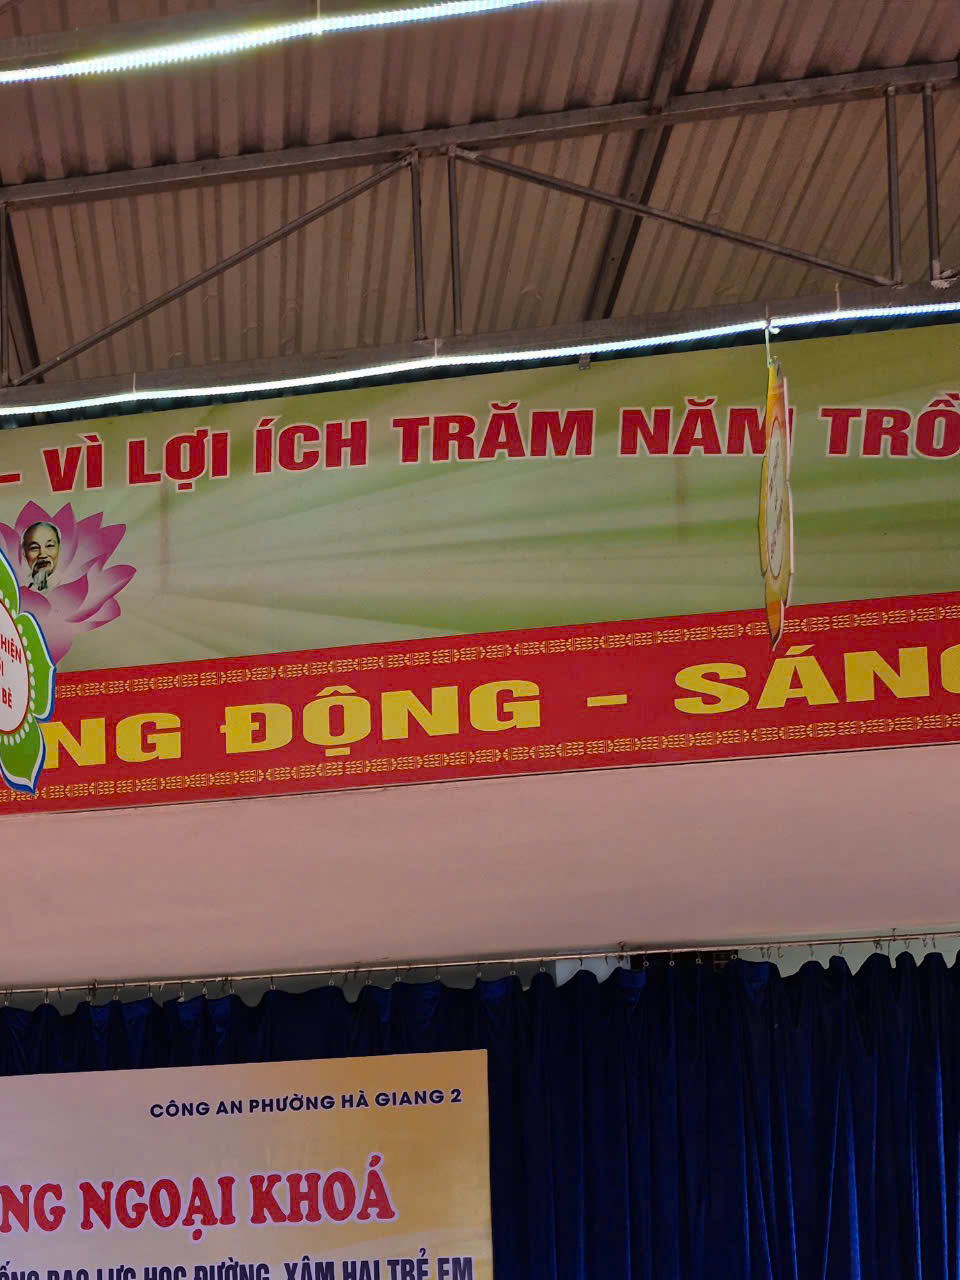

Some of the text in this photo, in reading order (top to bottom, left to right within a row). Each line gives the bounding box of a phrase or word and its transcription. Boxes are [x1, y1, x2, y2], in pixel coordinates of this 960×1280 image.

[43, 434, 103, 492] VÌ
[128, 429, 228, 491] LỢI
[255, 418, 367, 473] ÍCH
[392, 402, 594, 463] TRĂM
[620, 398, 793, 455] NĂM
[1, 687, 13, 709] BÈ
[219, 679, 541, 757] ĐỘNG
[150, 1088, 462, 1118] CÔNG AN PHƯỜNG HÀ GIANG 2
[79, 1175, 236, 1241] NGOẠI
[249, 1152, 395, 1225] KHOÁ
